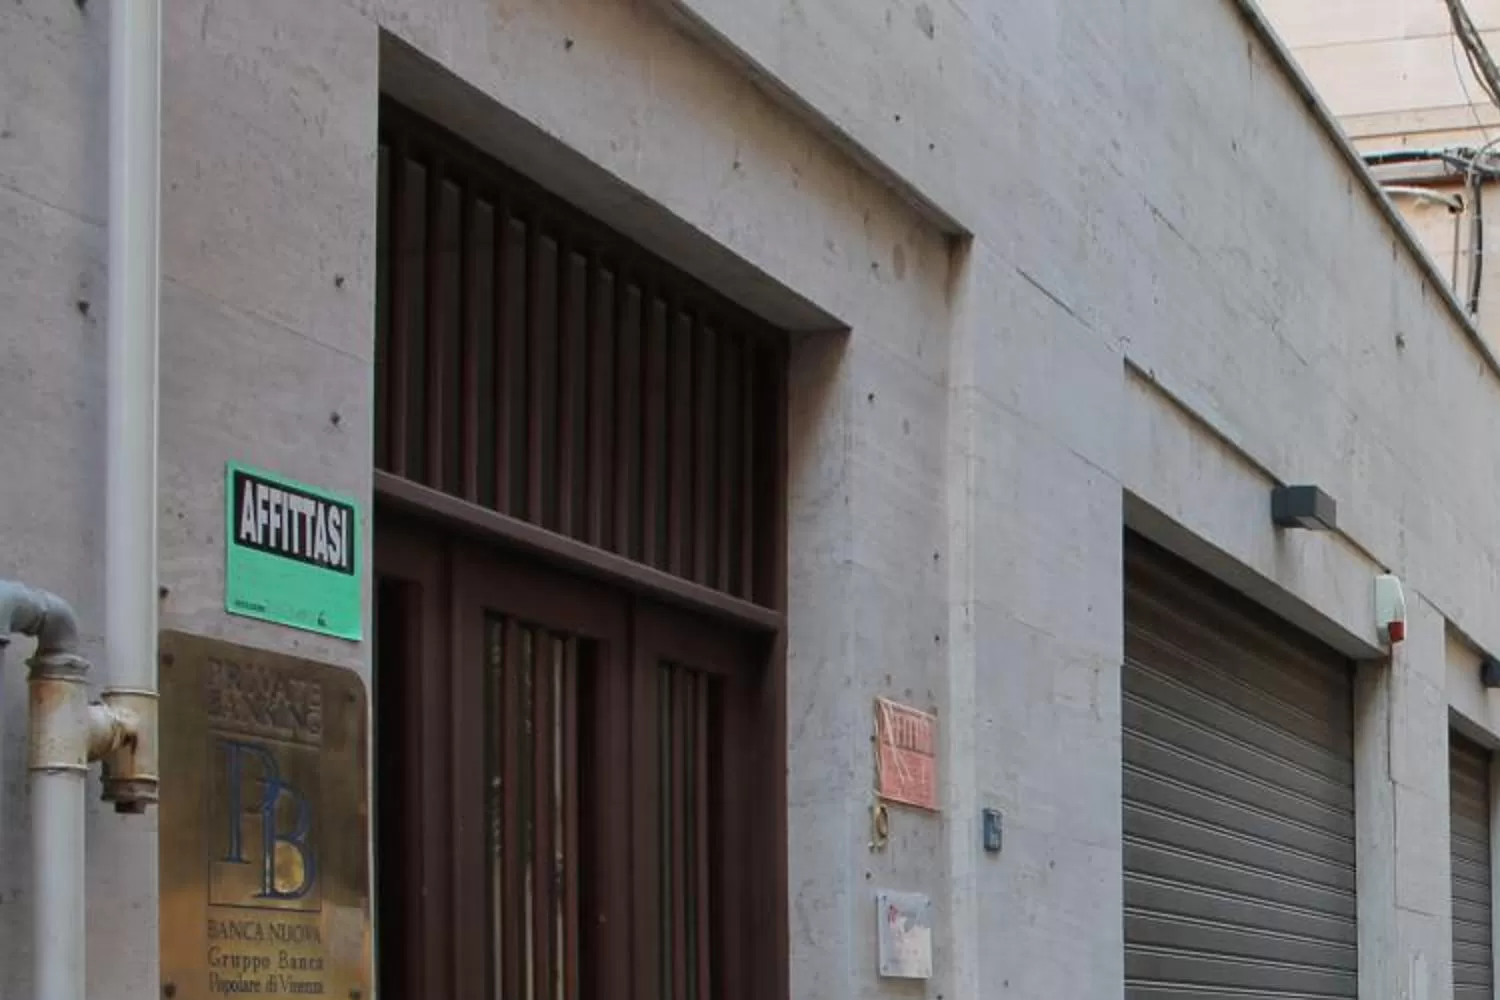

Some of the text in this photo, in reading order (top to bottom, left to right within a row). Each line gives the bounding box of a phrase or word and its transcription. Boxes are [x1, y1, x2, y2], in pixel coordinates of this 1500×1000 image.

[238, 478, 349, 567] AFFITTASI
[207, 919, 264, 941] BANCA
[207, 946, 271, 973] Gruppo
